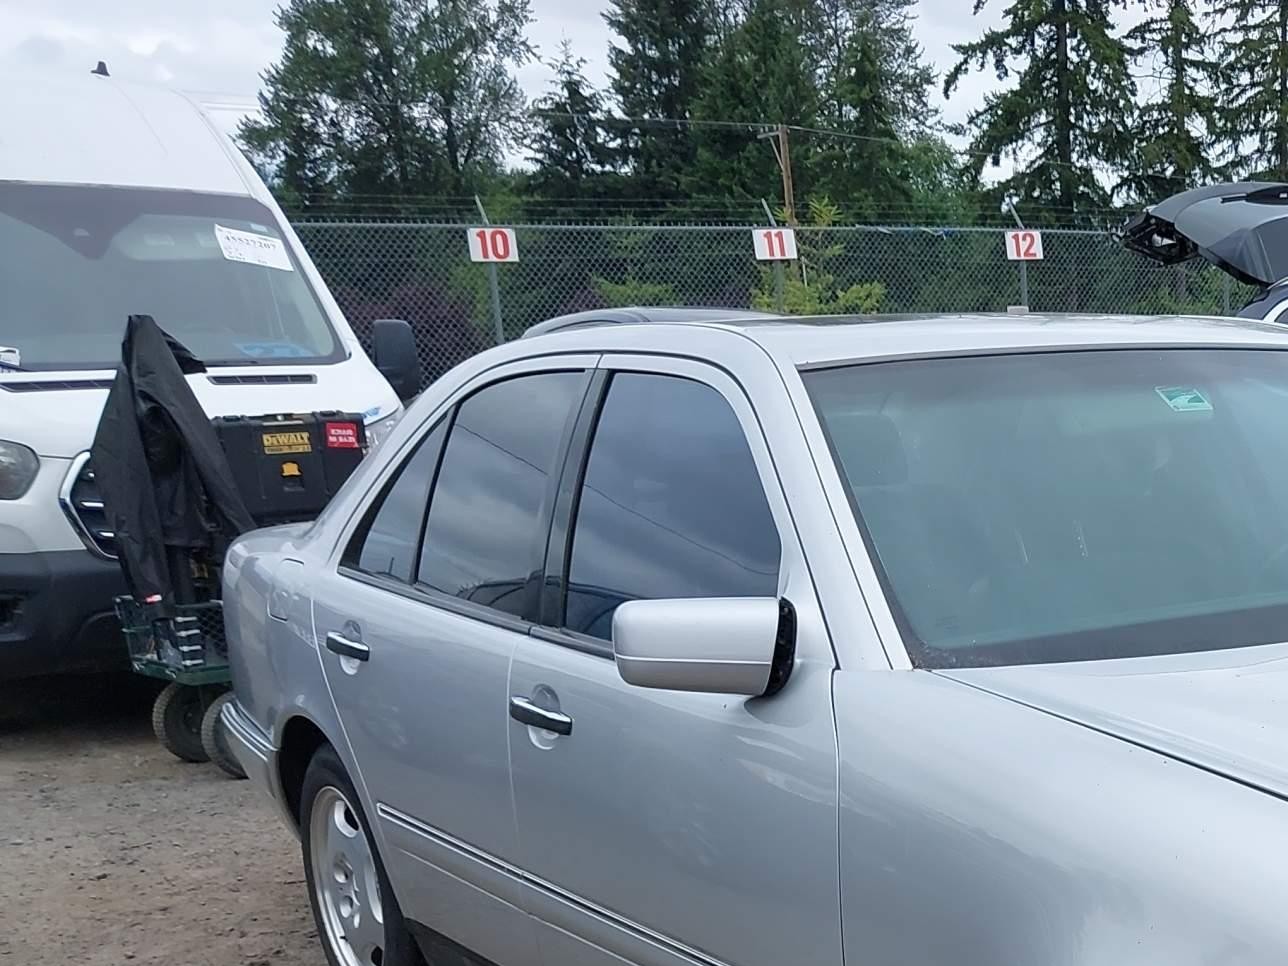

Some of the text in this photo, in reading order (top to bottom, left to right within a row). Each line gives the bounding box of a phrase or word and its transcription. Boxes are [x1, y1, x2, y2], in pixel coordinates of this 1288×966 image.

[475, 229, 510, 260] 10
[763, 230, 787, 257] 11
[1011, 232, 1038, 258] 12
